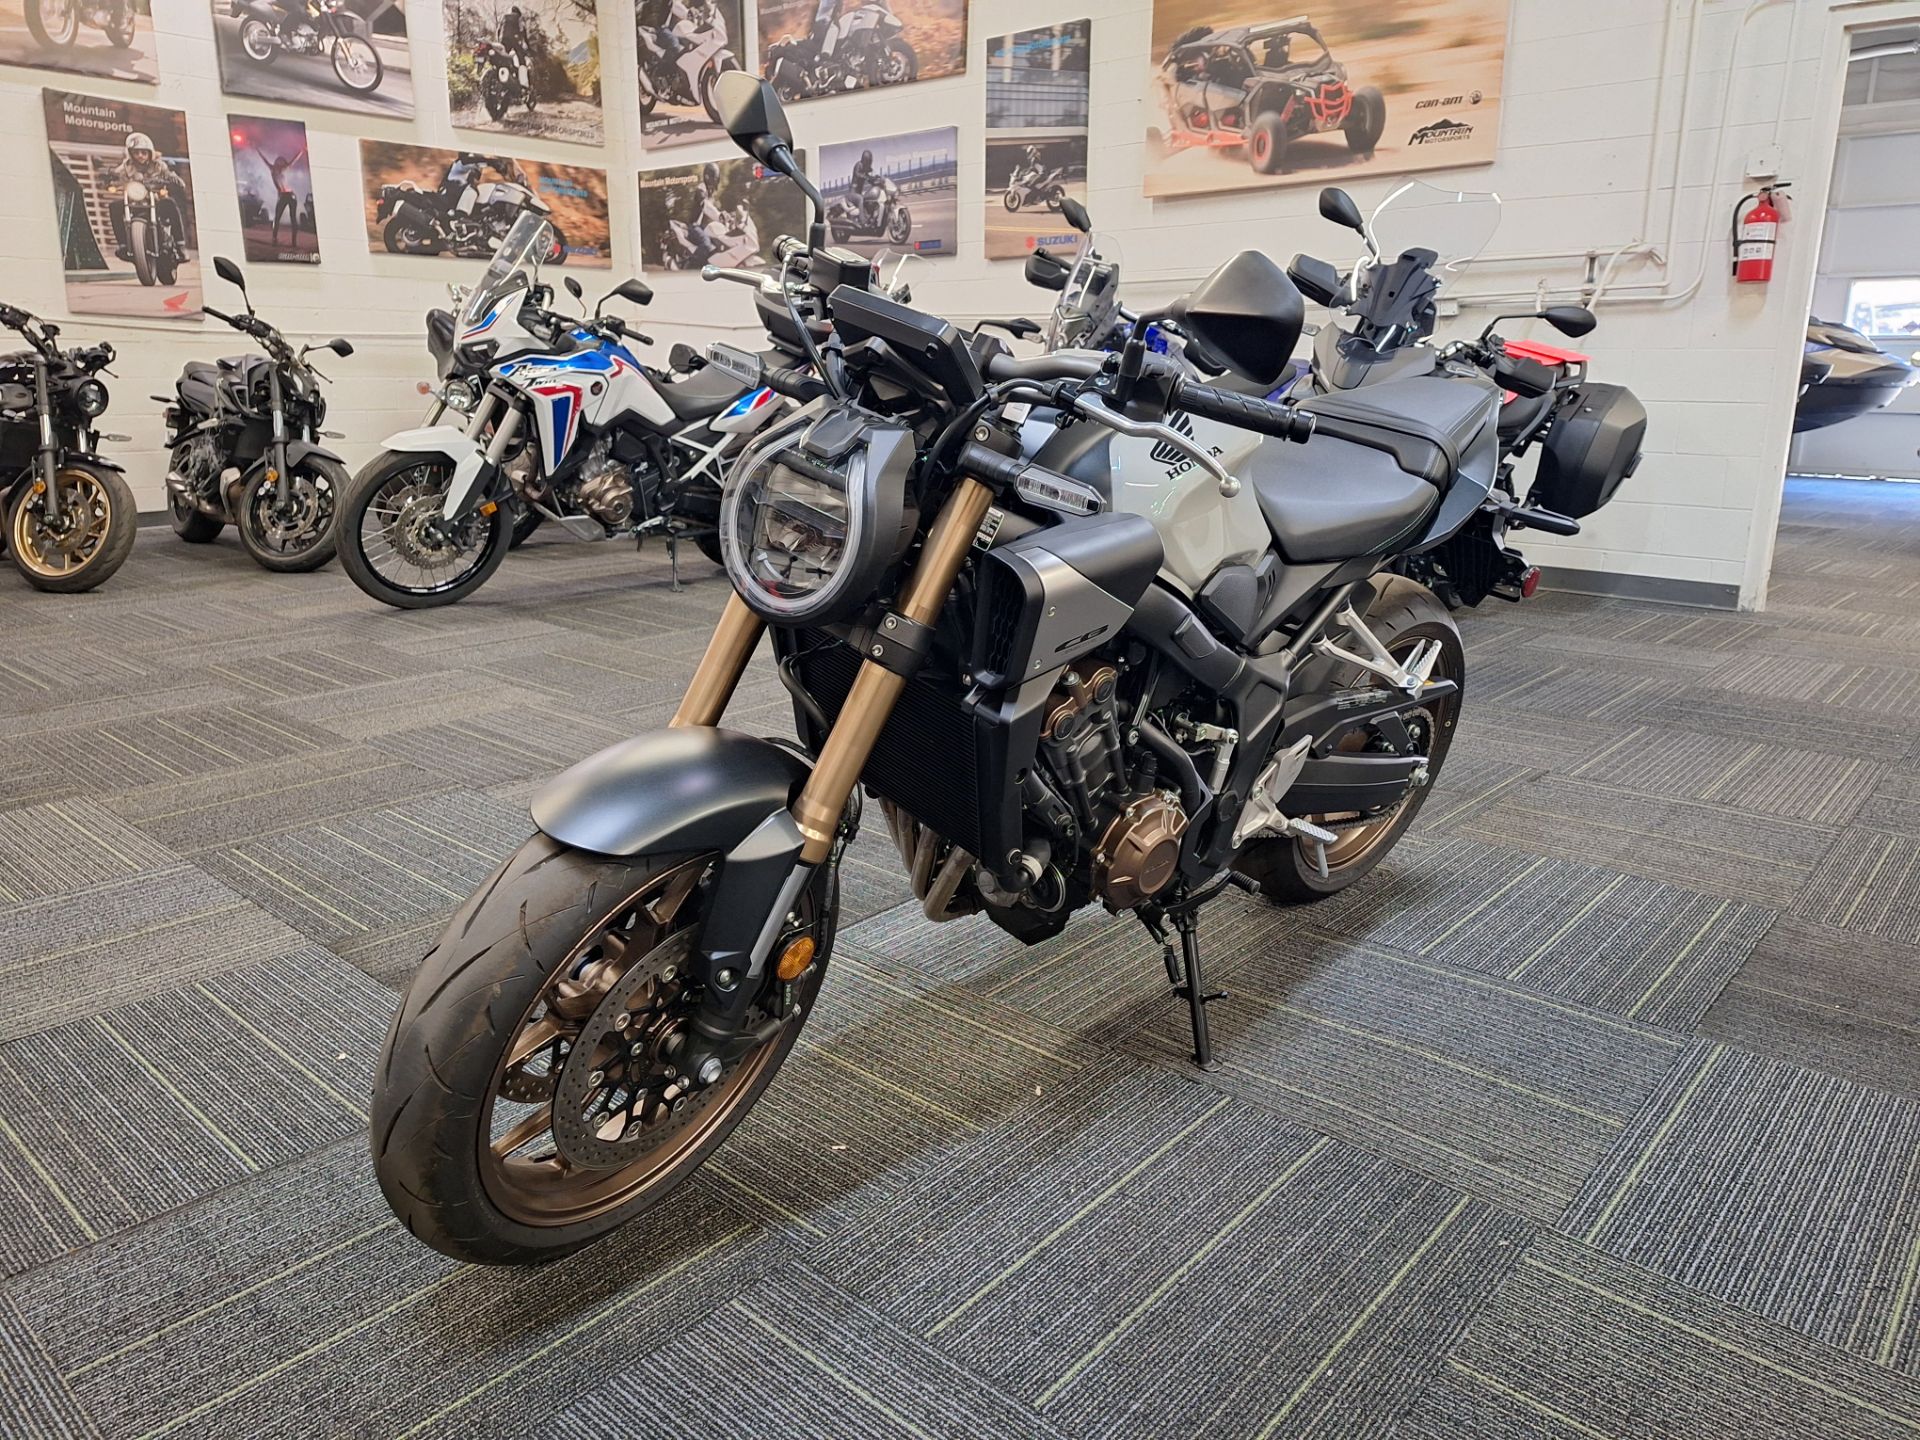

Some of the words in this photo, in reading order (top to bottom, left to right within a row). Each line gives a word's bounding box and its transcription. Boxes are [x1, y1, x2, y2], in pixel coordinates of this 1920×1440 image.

[1415, 96, 1463, 109] can-am
[63, 101, 116, 118] Mountain
[64, 114, 134, 133] Motorsports
[1424, 134, 1470, 144] MOTORSPORTS
[1037, 234, 1078, 246] SUZUKI
